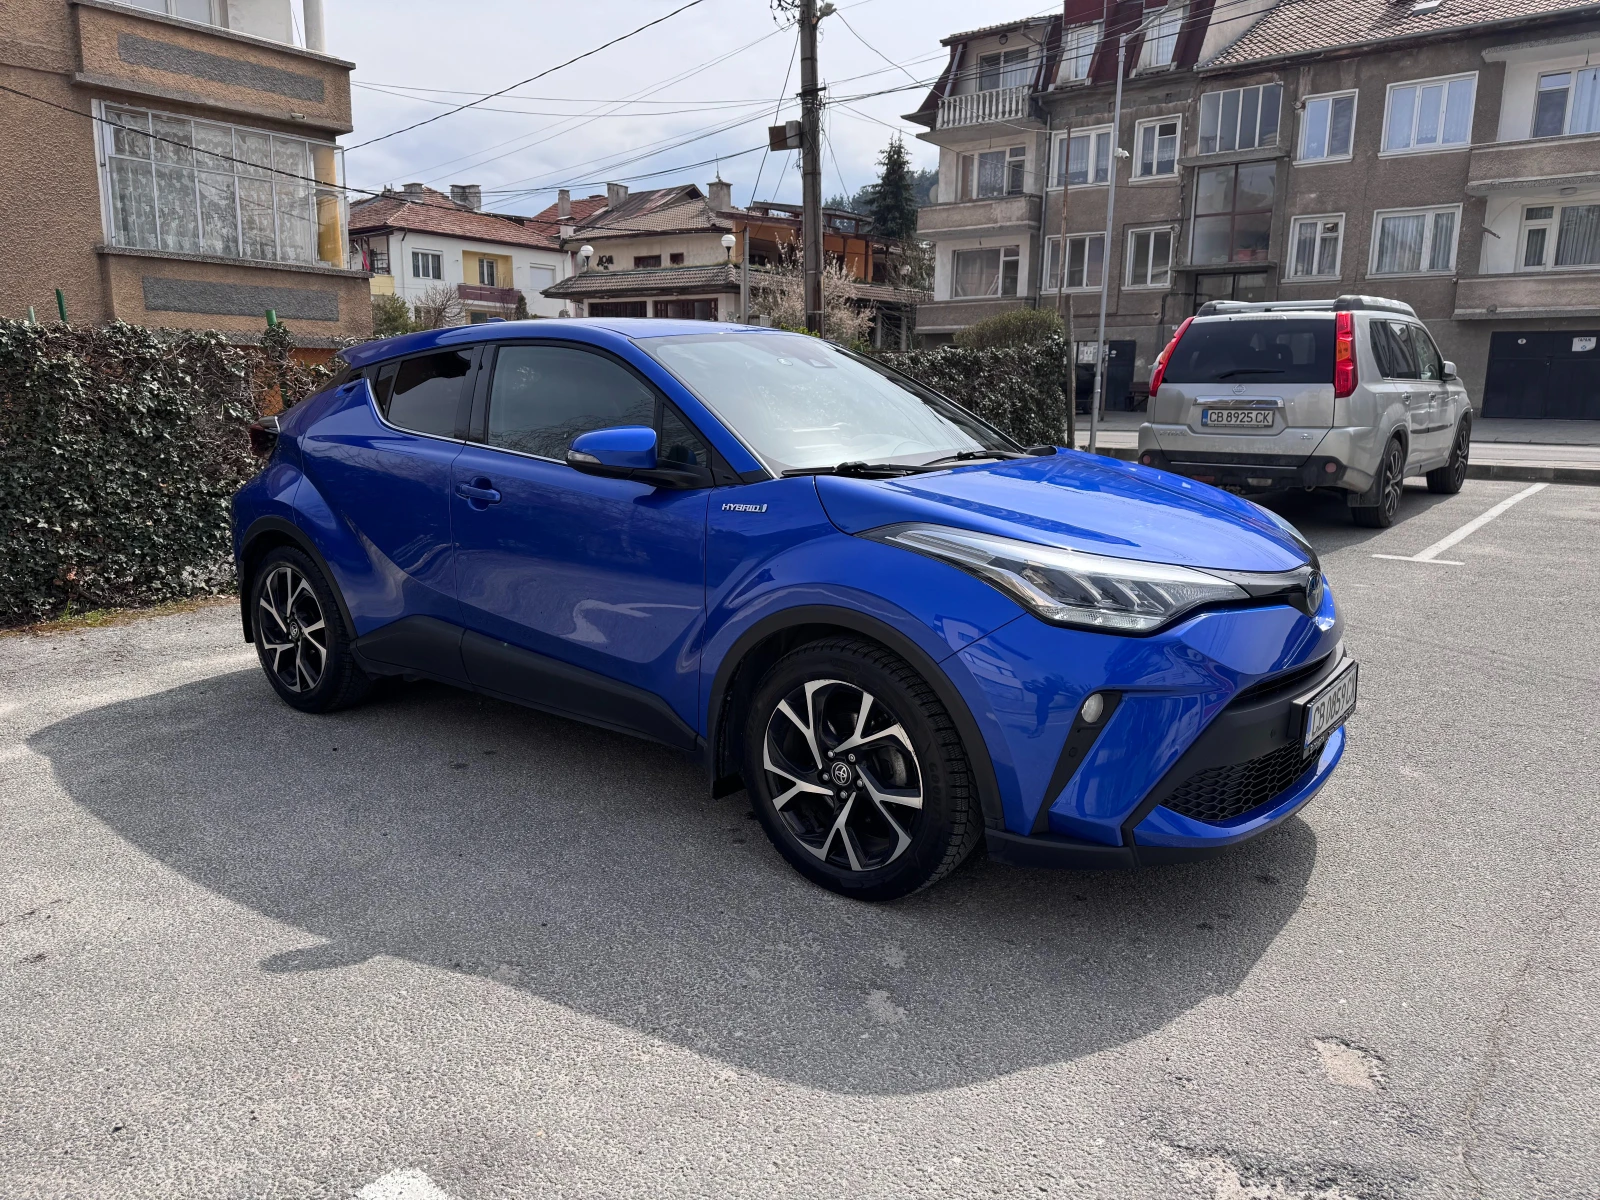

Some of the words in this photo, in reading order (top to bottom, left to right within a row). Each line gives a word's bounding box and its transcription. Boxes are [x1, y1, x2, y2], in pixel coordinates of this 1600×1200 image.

[1209, 411, 1224, 423] CB
[1225, 411, 1253, 424] 8925
[1255, 411, 1271, 424] CK
[722, 503, 761, 512] HYBRID
[1312, 702, 1326, 737] CB
